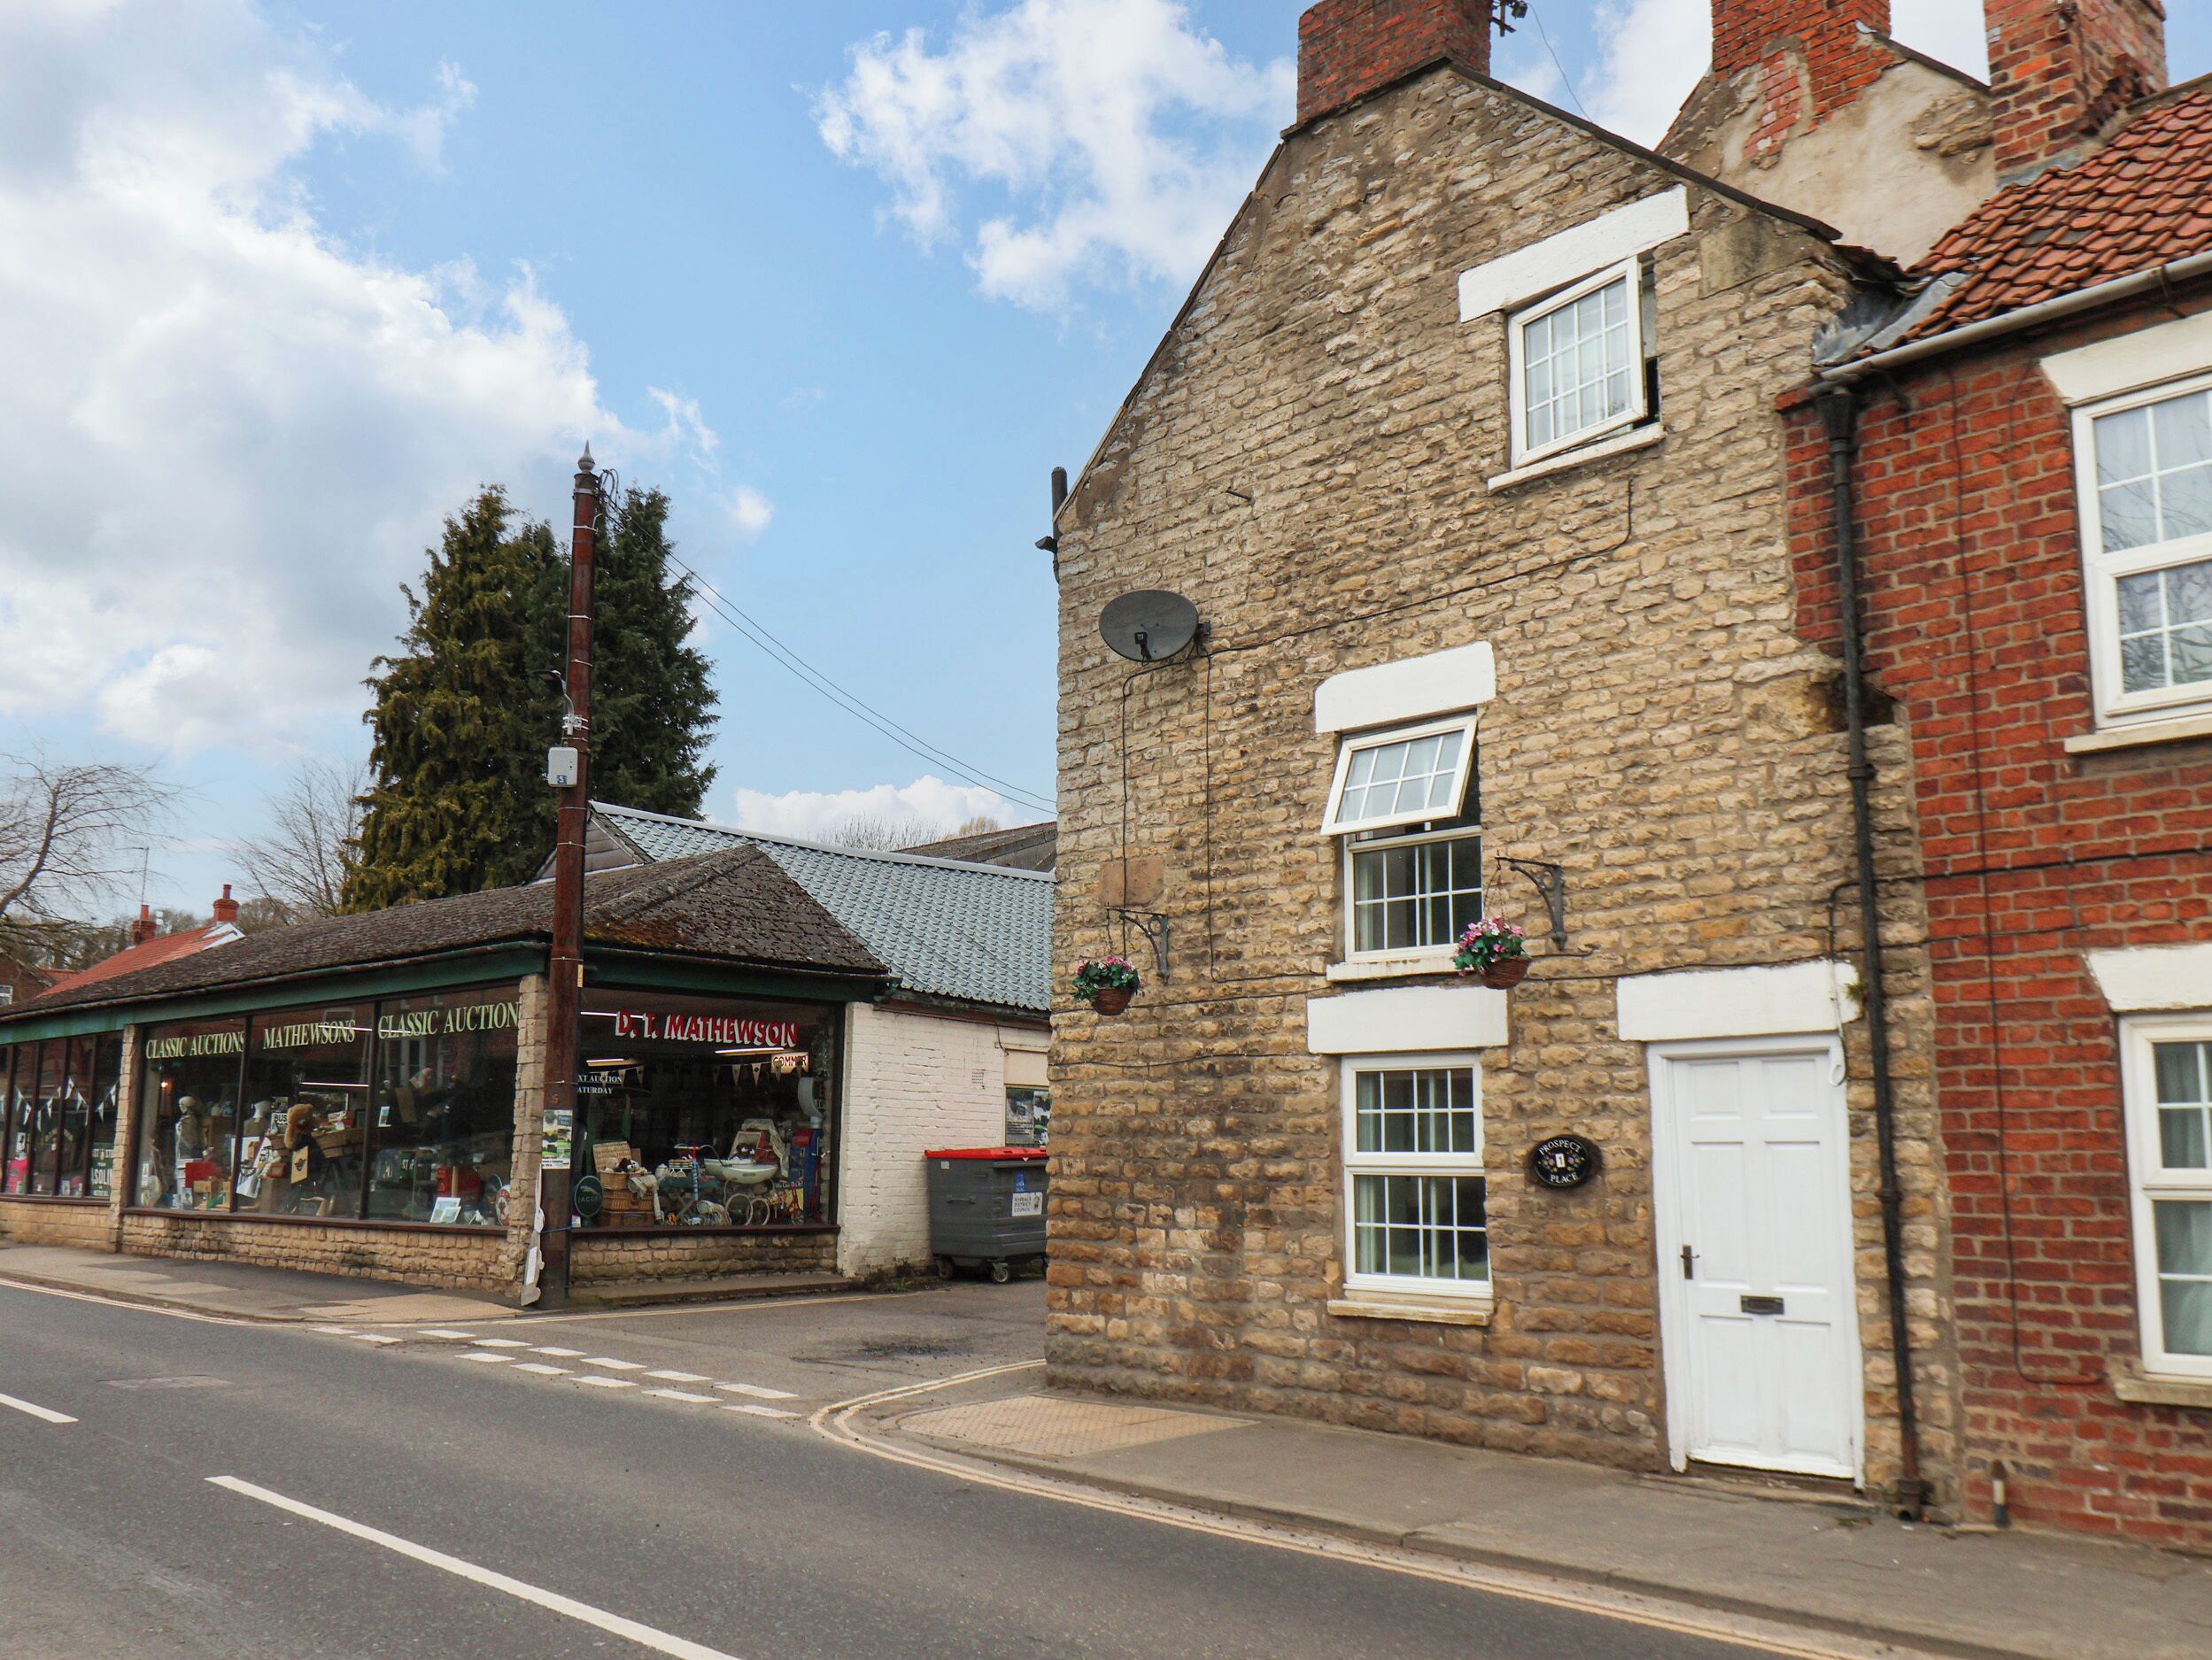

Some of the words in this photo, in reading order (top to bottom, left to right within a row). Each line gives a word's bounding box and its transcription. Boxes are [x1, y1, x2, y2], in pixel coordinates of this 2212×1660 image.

[263, 1019, 356, 1050] MATHEWSONS
[378, 1010, 439, 1039] CLASSIC
[615, 1010, 638, 1039] D.
[642, 1011, 661, 1039] T.
[664, 1013, 800, 1047] MATHEWSON
[146, 1037, 188, 1059] CLASSIC
[189, 1031, 245, 1056] AUCTIONS
[577, 1086, 614, 1095] ATURDAY
[590, 1075, 623, 1084] AUCTION
[1538, 1139, 1582, 1155] PROSPECT
[1550, 1172, 1579, 1184] PLACE
